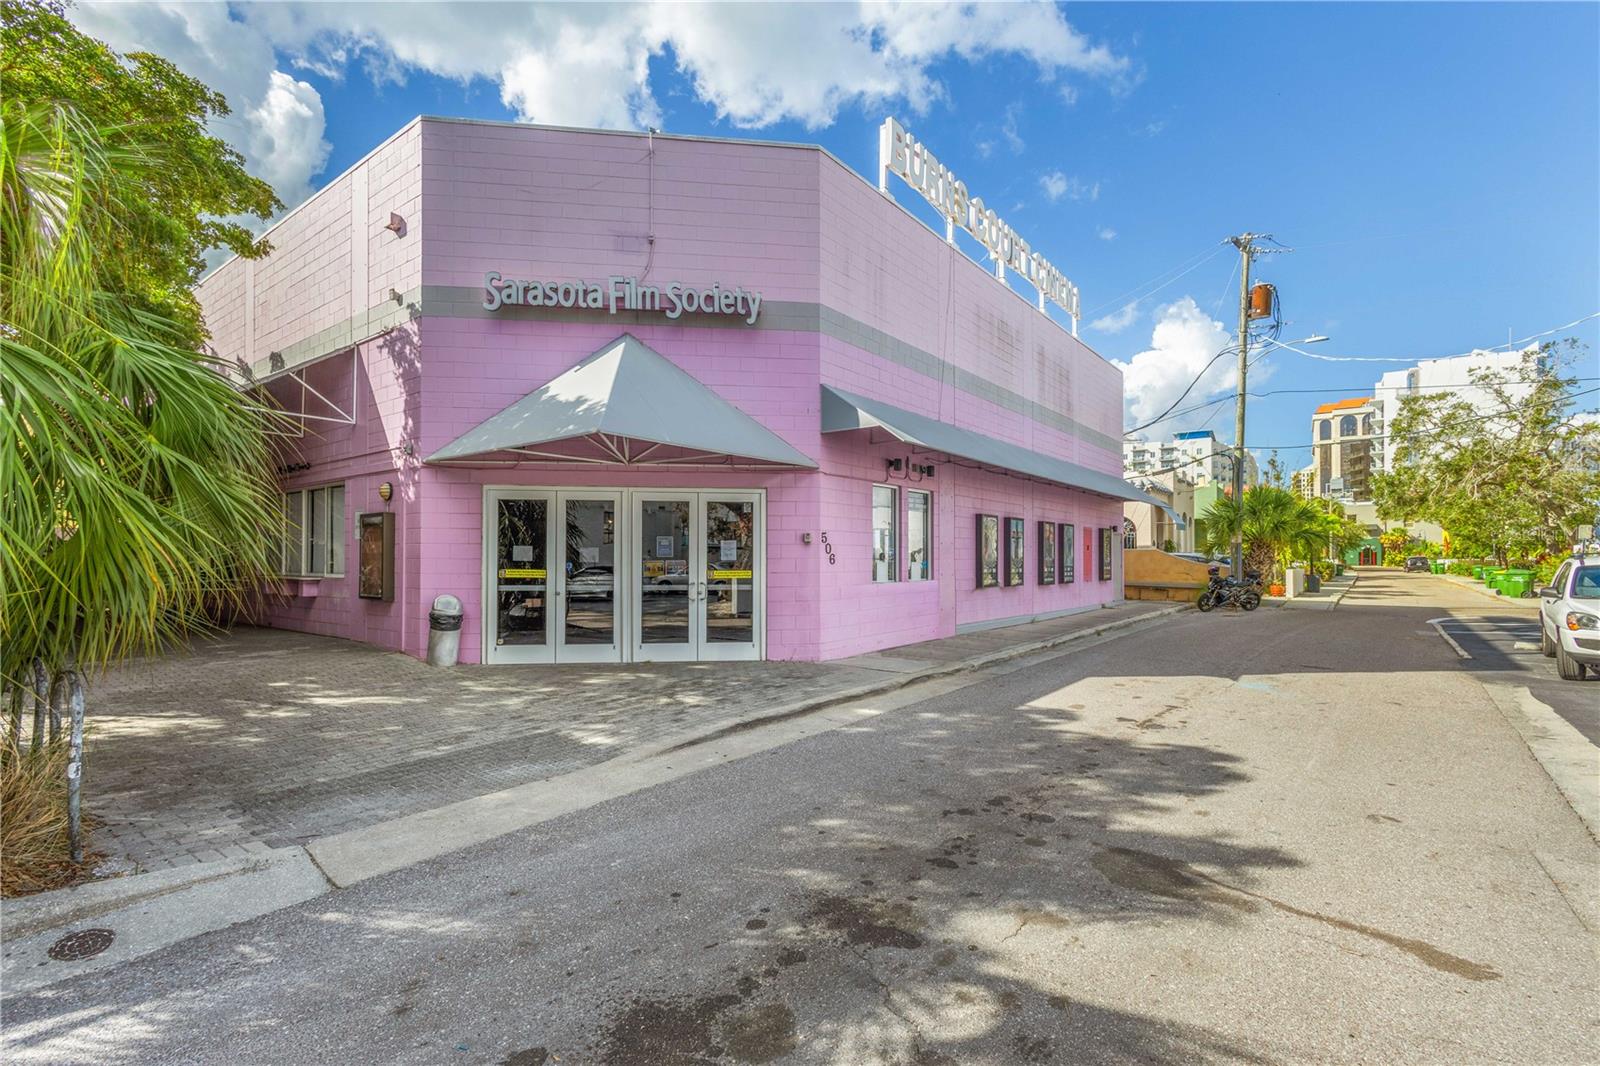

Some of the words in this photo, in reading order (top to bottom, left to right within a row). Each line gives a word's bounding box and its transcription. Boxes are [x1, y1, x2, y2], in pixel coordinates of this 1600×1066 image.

[885, 116, 968, 228] BURNS
[969, 197, 1031, 277] COURT
[483, 271, 604, 311] Sarasota
[608, 275, 660, 314] Film
[665, 281, 762, 325] Society
[821, 532, 836, 565] 506
